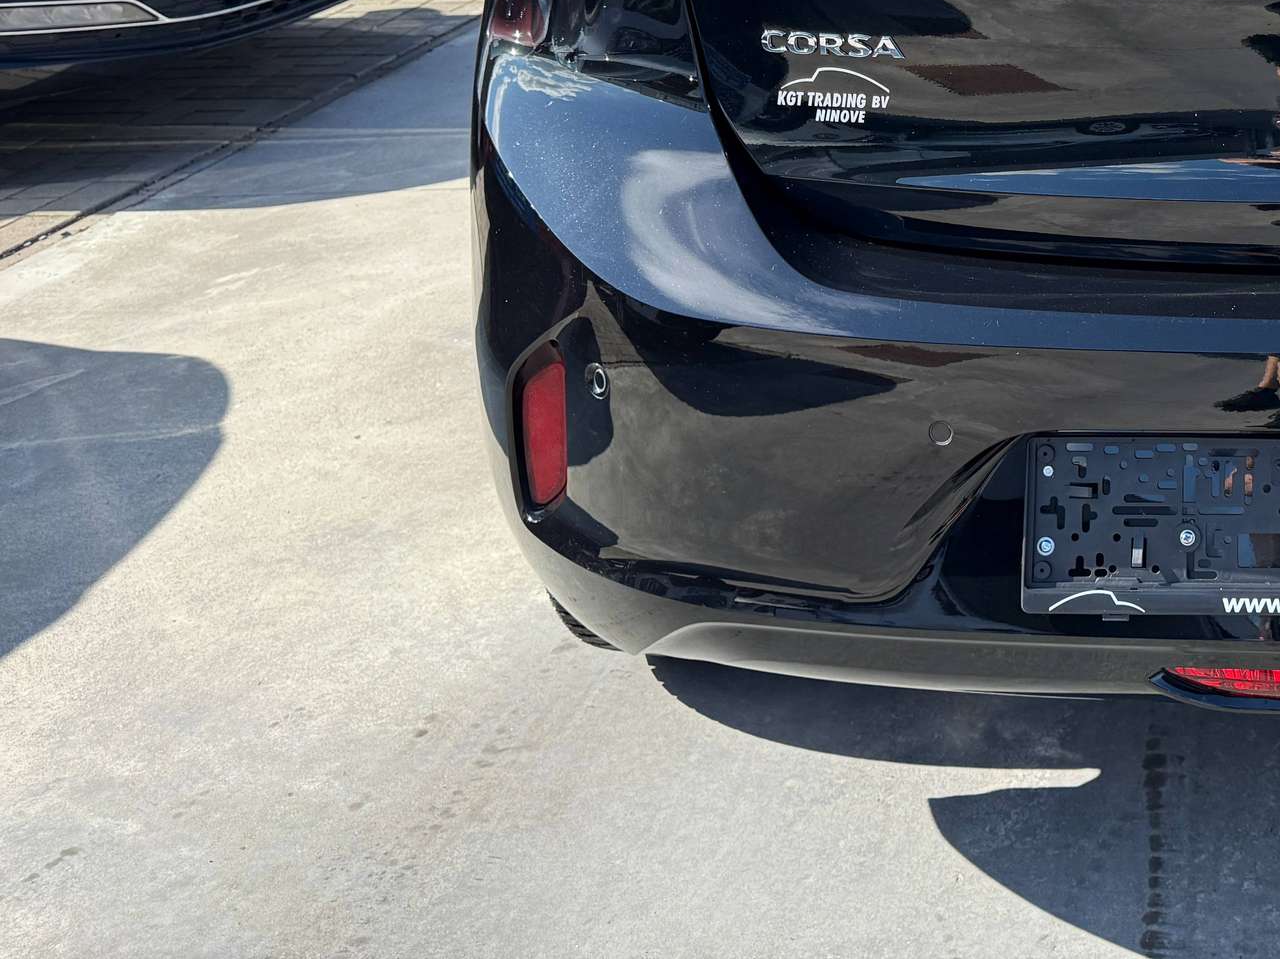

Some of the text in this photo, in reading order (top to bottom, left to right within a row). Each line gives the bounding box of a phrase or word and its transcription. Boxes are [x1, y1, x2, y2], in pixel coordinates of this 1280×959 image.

[760, 29, 905, 59] CORSA
[777, 91, 890, 109] KGT TRADING BV
[815, 109, 866, 123] NINOVE
